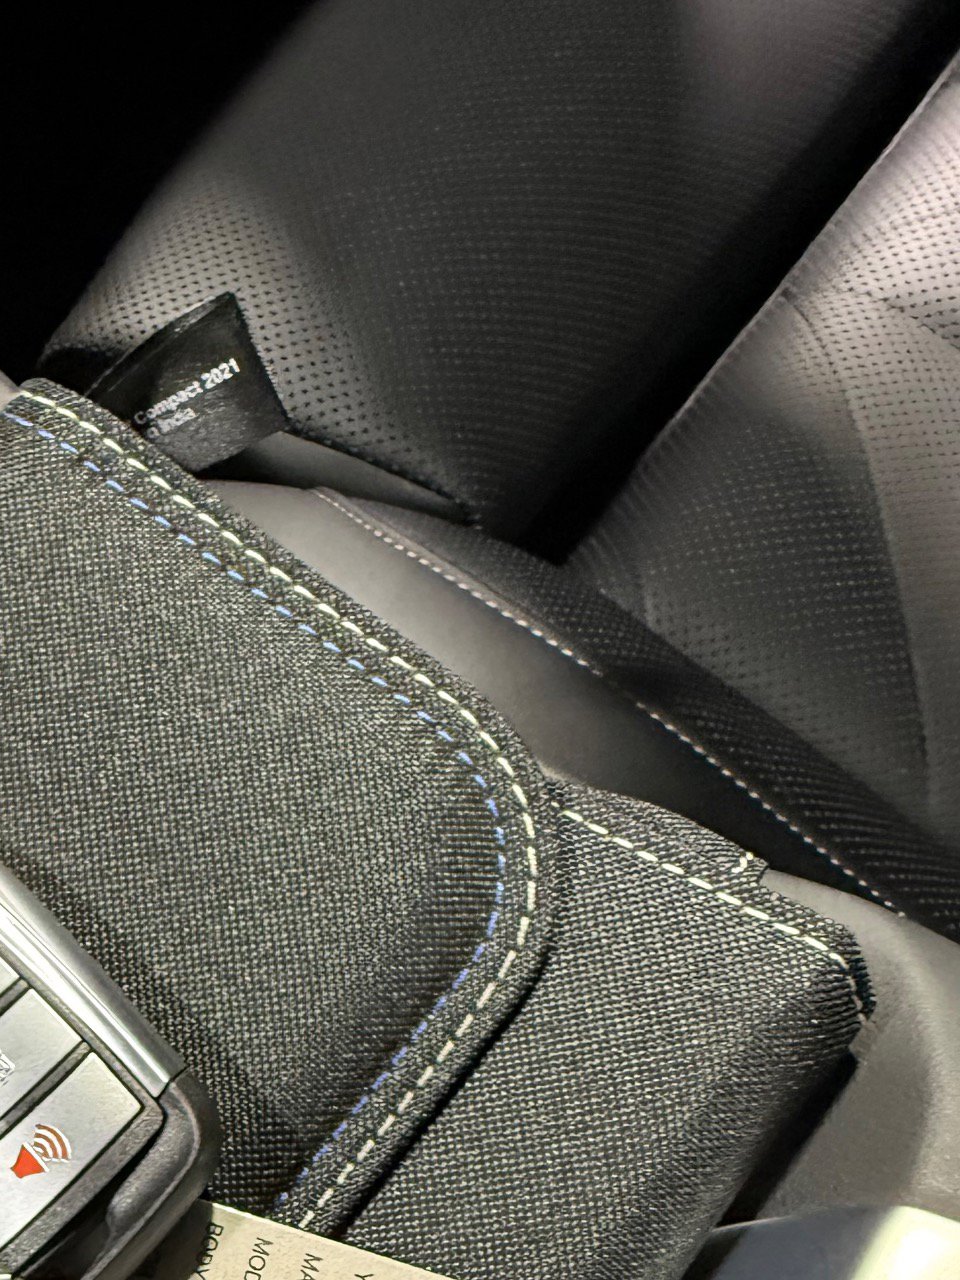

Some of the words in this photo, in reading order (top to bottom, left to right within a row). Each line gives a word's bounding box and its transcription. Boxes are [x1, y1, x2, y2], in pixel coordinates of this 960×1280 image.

[134, 381, 203, 424] Compact
[201, 358, 240, 389] 2021
[195, 1223, 224, 1280] BODY
